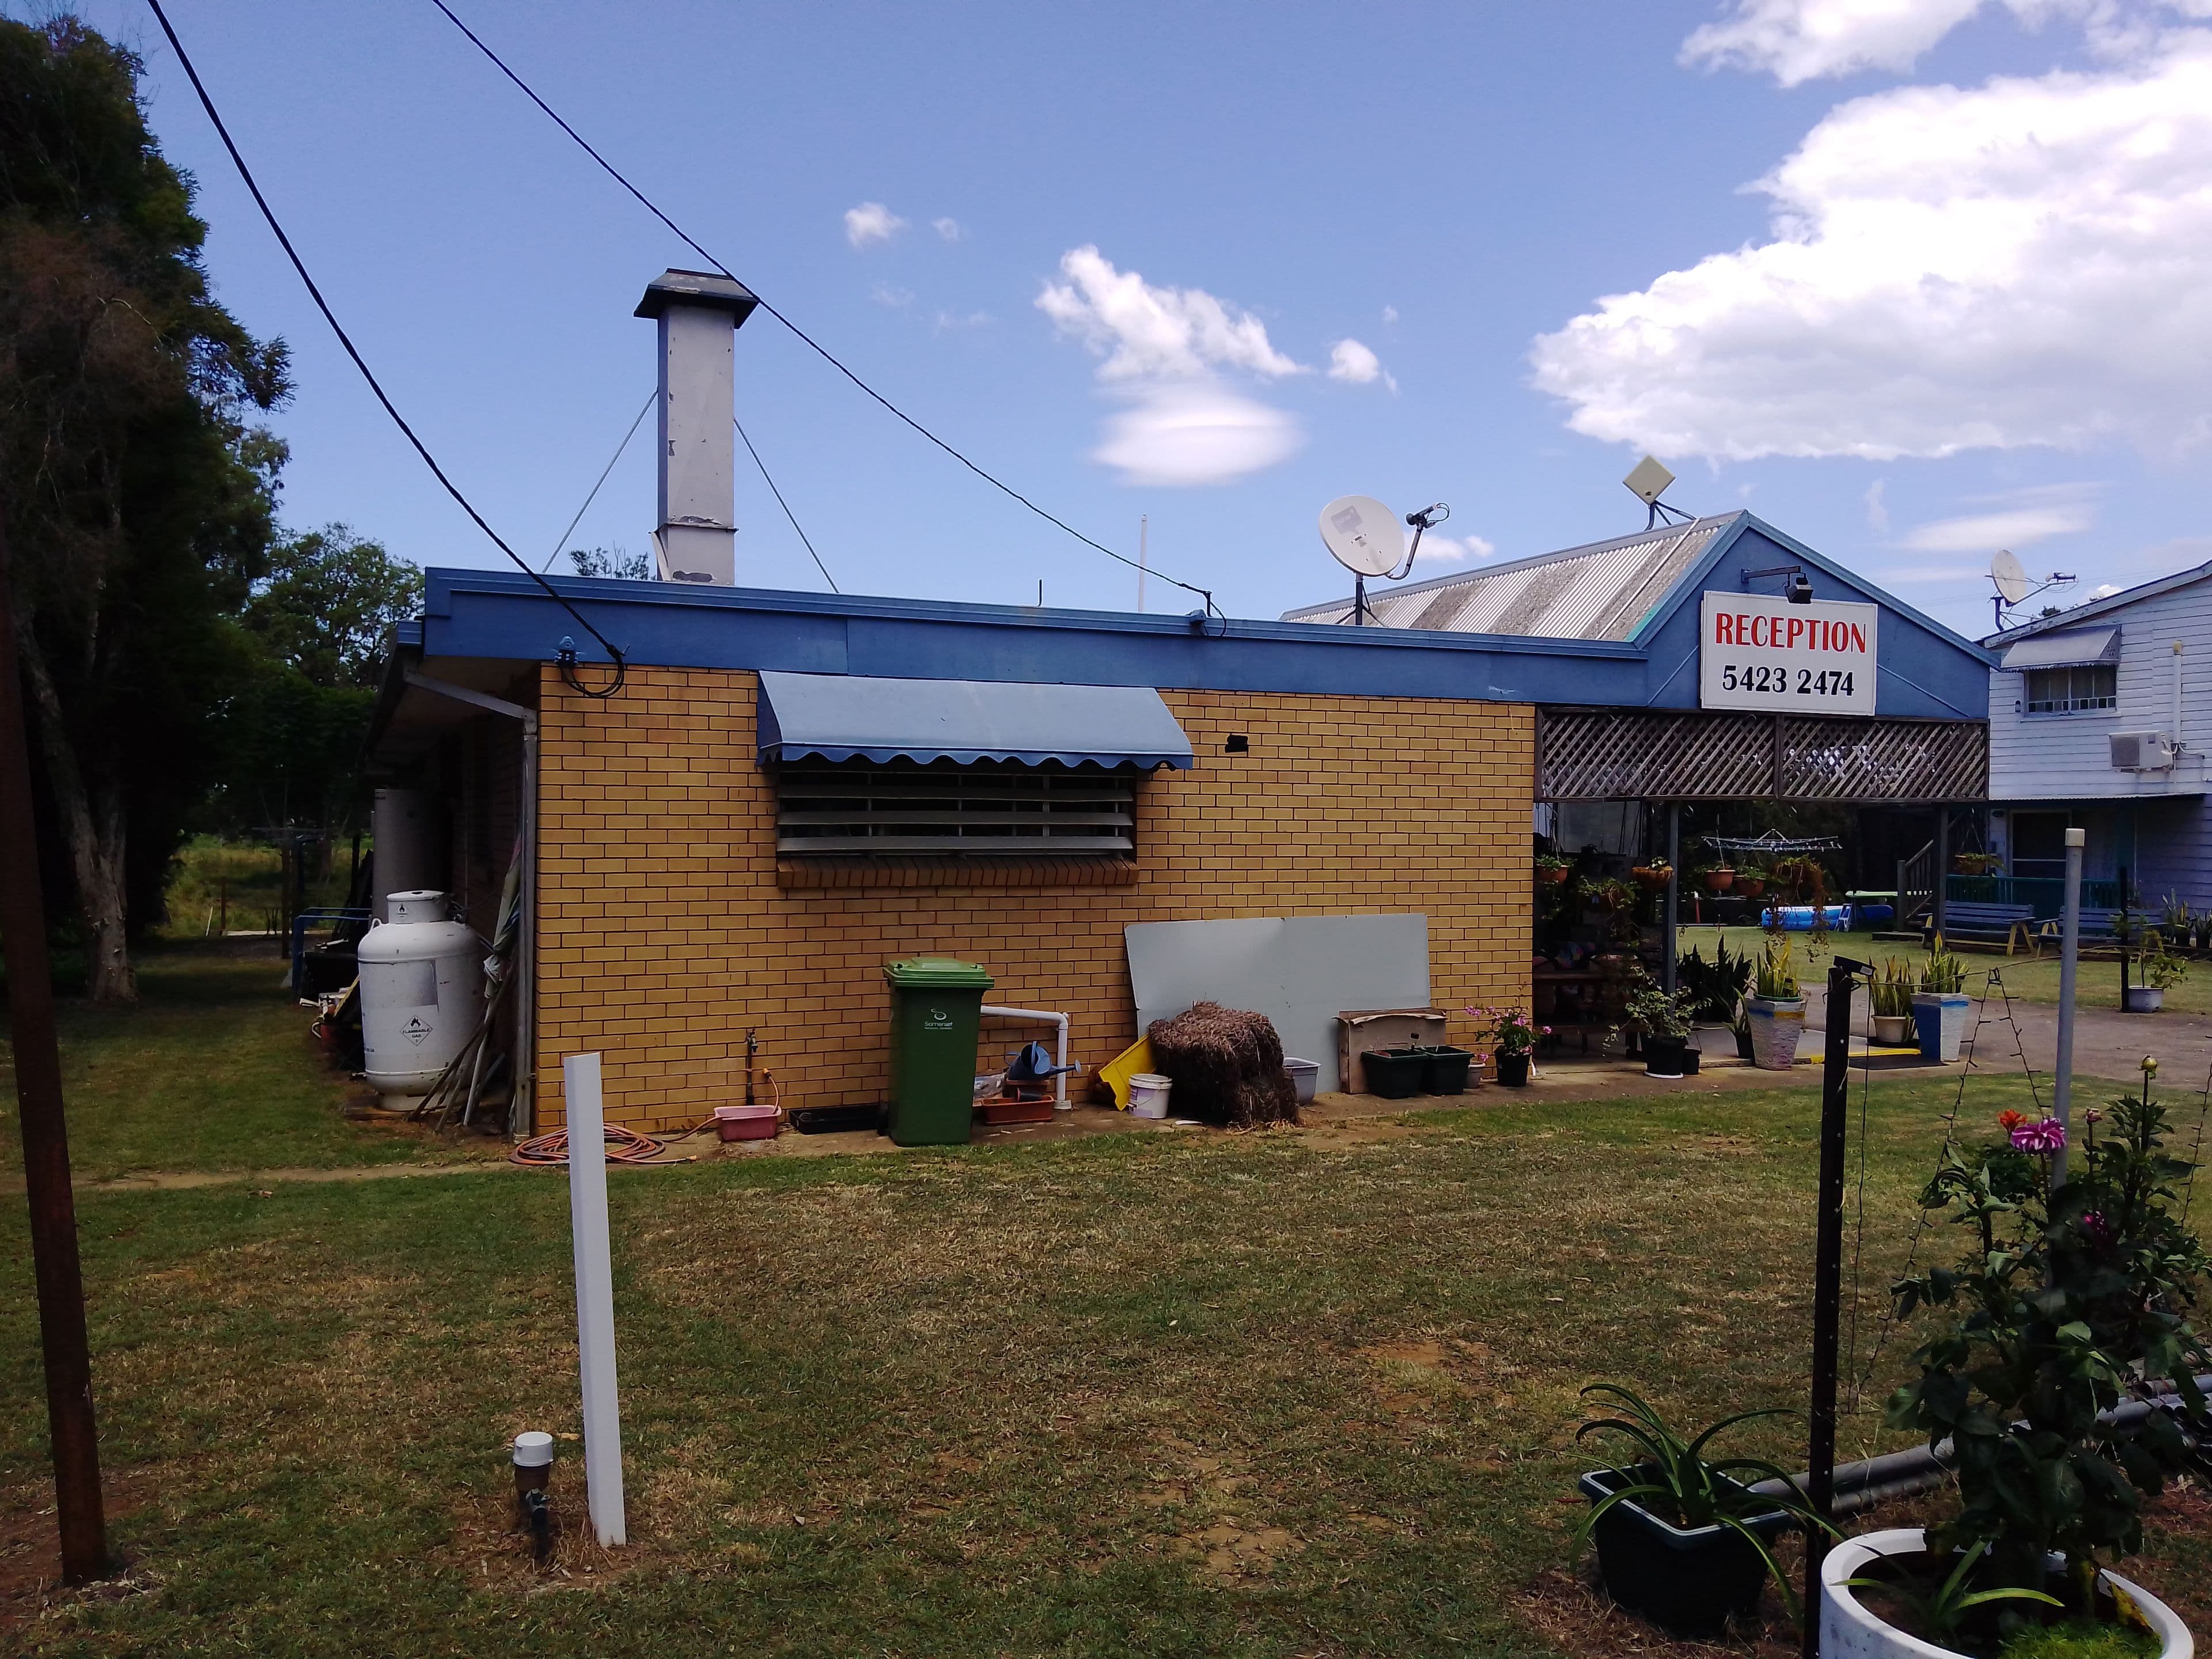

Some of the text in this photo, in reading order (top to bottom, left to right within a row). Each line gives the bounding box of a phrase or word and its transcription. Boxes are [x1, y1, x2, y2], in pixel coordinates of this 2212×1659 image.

[1715, 612, 1866, 653] RECEPTION
[1722, 665, 1854, 696] 5423 2474
